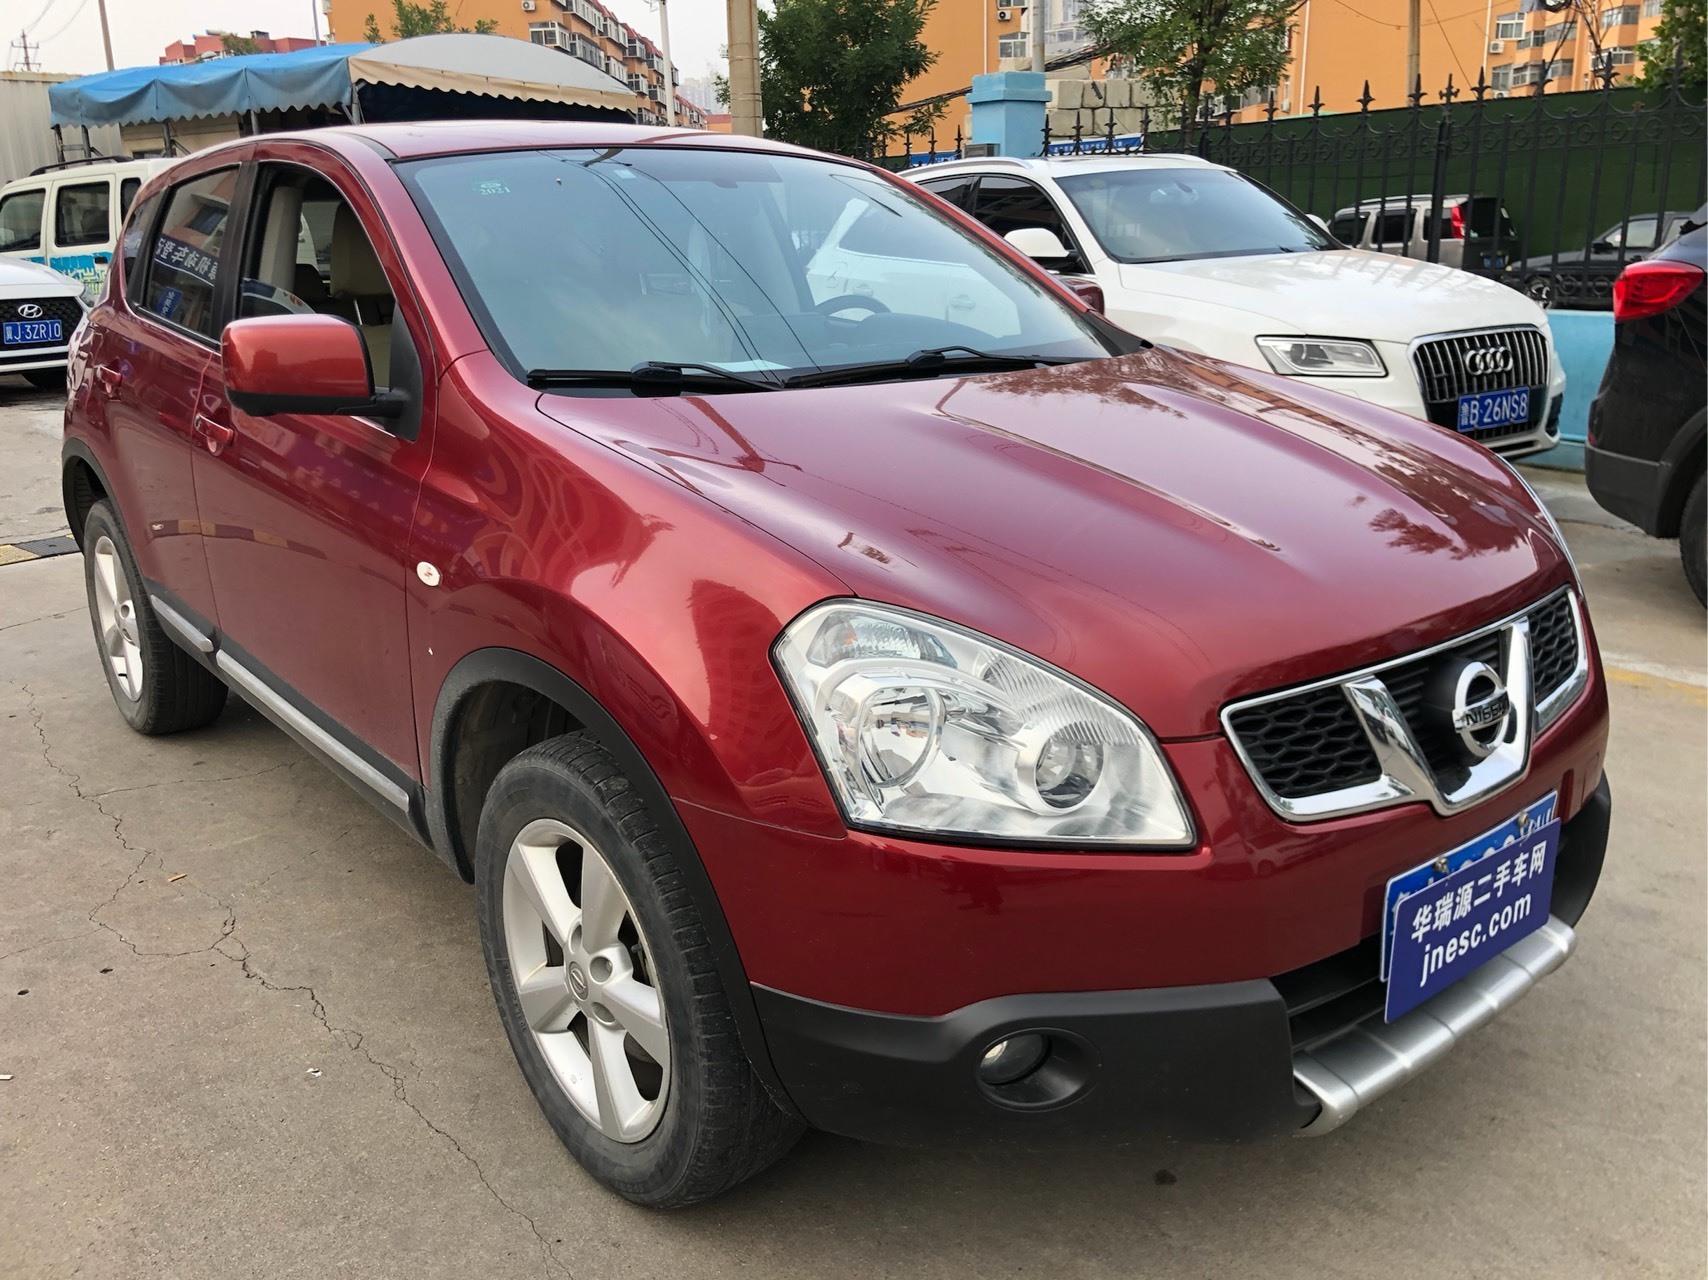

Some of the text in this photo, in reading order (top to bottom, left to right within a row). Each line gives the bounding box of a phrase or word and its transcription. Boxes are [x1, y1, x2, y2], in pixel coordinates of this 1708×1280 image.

[1410, 840, 1547, 943] 华瑞源二手车网
[1420, 893, 1532, 987] jnesc.com
